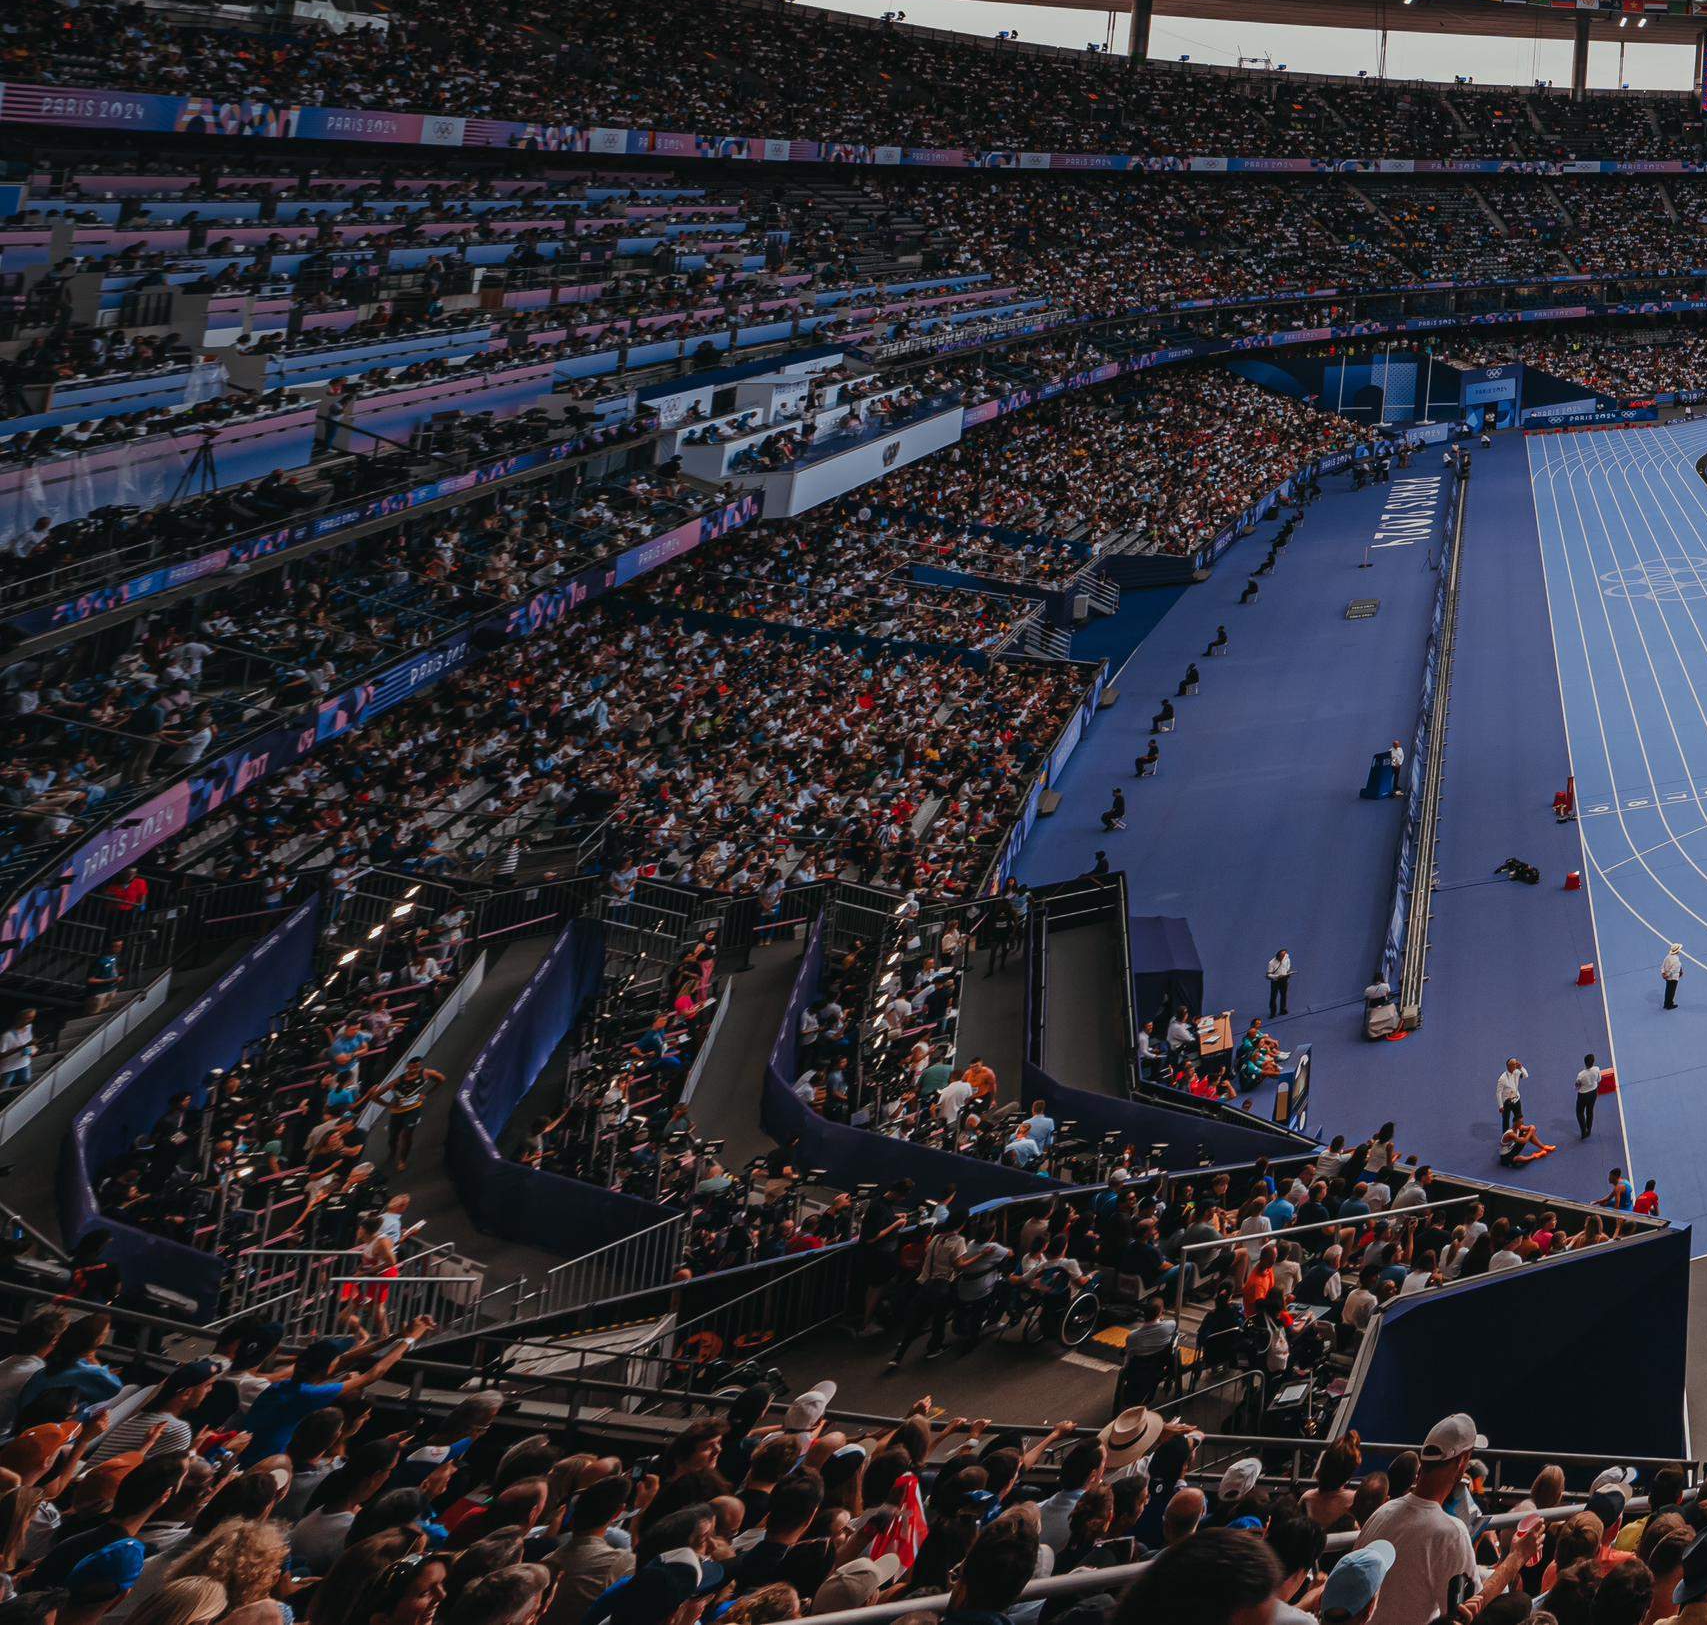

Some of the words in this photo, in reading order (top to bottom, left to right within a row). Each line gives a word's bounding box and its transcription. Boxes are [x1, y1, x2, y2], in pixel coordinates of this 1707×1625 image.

[41, 97, 95, 117] PARIS
[99, 100, 145, 120] 2024
[326, 116, 366, 133] PARIS
[366, 118, 398, 134] 2024
[663, 139, 685, 150] 2024
[1065, 159, 1087, 167] PARIS
[1089, 159, 1113, 168] 2024
[1244, 160, 1269, 168] PARIS
[1271, 160, 1294, 169] 2024
[1569, 413, 1593, 422] PARIS
[1595, 412, 1616, 420] 2024
[1420, 428, 1441, 438] 2024
[1383, 476, 1442, 511] PARIS
[1370, 510, 1436, 549] 2024
[409, 658, 443, 687] PARIS
[81, 834, 127, 884] PARIS
[130, 809, 173, 849] 2024
